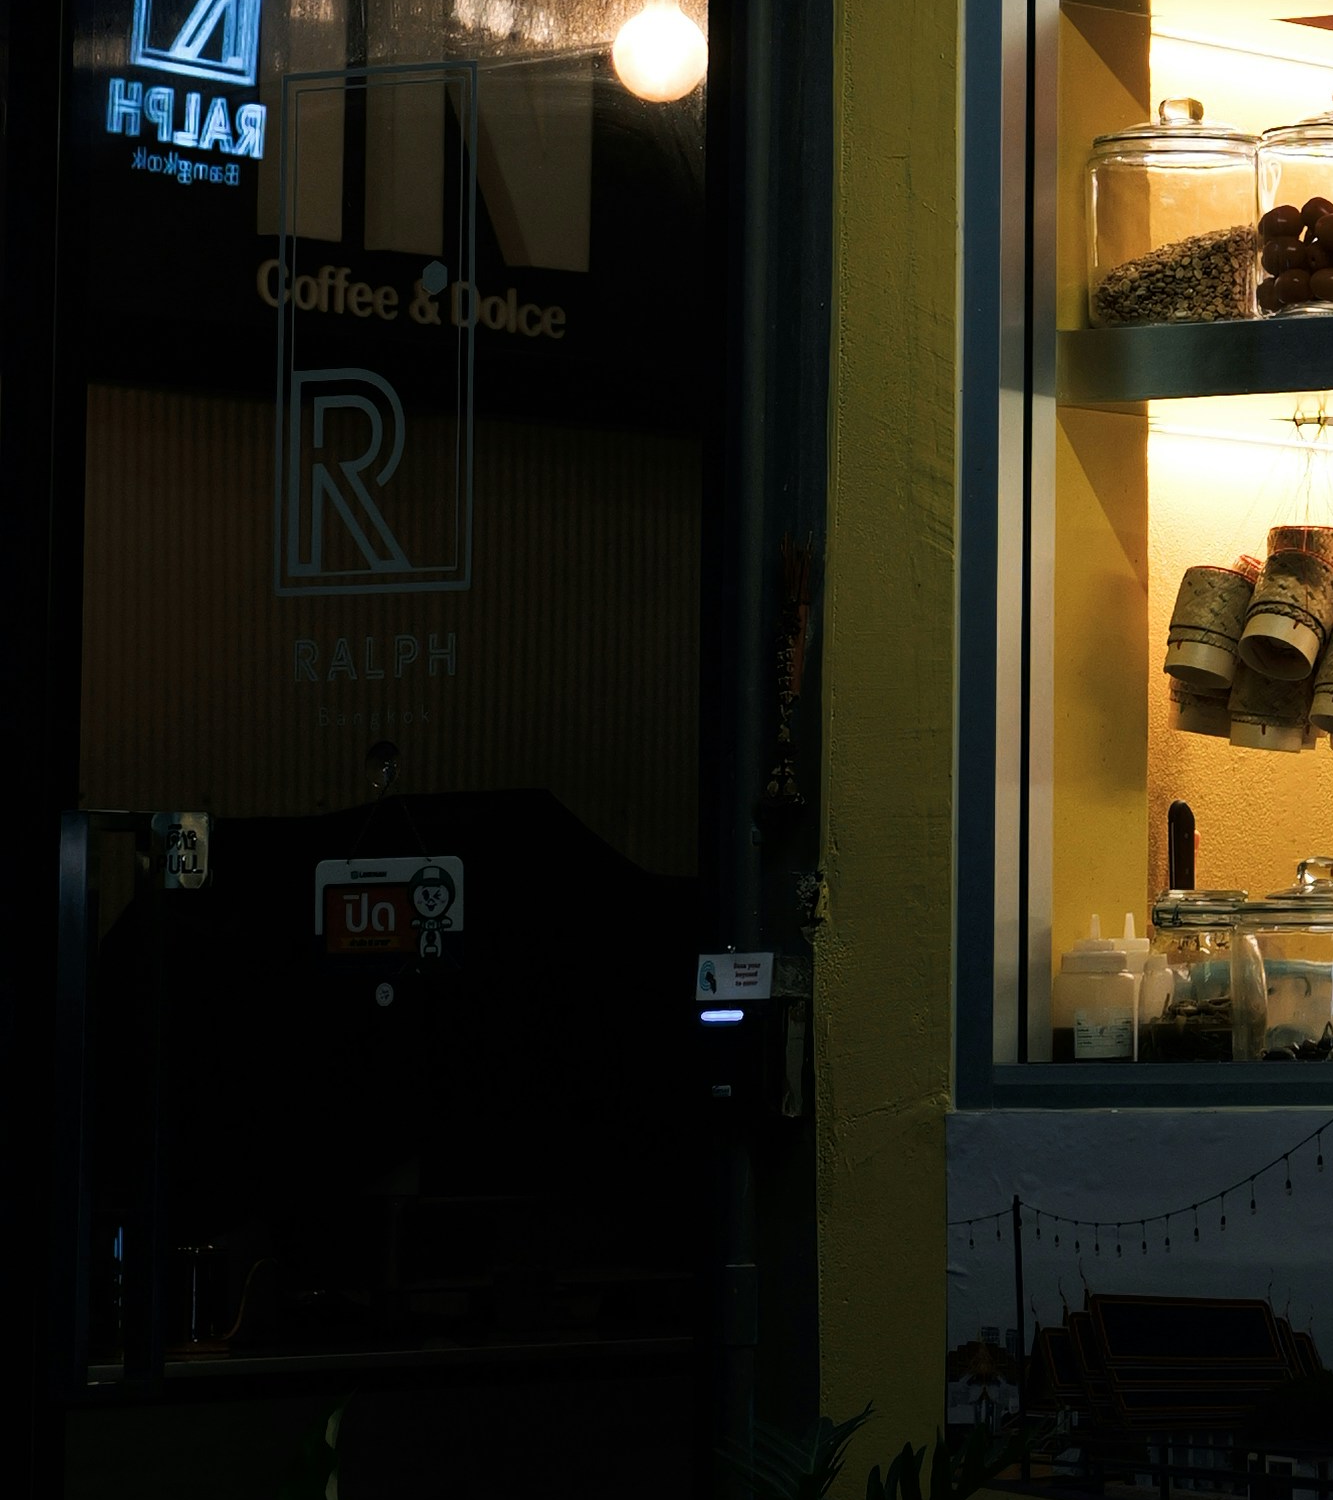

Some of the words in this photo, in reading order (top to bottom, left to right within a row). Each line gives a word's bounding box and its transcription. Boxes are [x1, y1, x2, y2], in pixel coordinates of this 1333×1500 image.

[255, 256, 399, 322] Coffee
[449, 279, 568, 342] Dolce
[293, 631, 458, 682] RALPH
